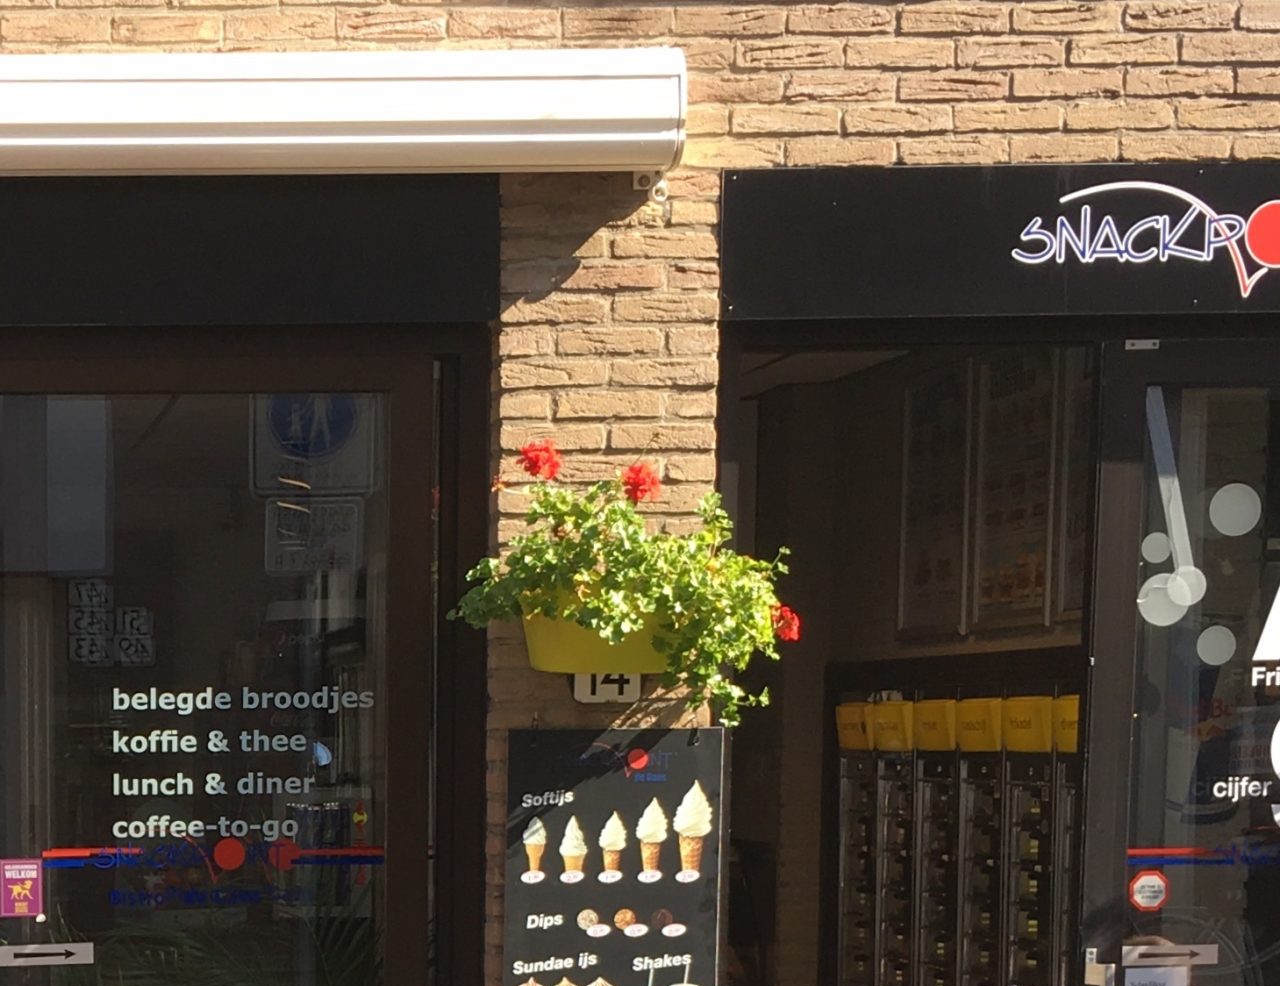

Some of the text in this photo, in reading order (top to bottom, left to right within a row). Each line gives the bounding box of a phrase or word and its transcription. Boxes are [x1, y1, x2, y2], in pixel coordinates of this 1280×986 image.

[589, 673, 631, 696] 14
[111, 686, 375, 716] belegde broodjes
[111, 729, 308, 753] koffie & thee
[111, 771, 316, 796] lunch & diner
[1212, 776, 1273, 803] cijfer
[521, 789, 574, 809] Softijs
[111, 815, 300, 842] coffee-to-go
[5, 869, 38, 879] WELKOM
[526, 913, 564, 930] Dips
[512, 952, 598, 975] Sundae ijs
[631, 953, 693, 972] Shakes
